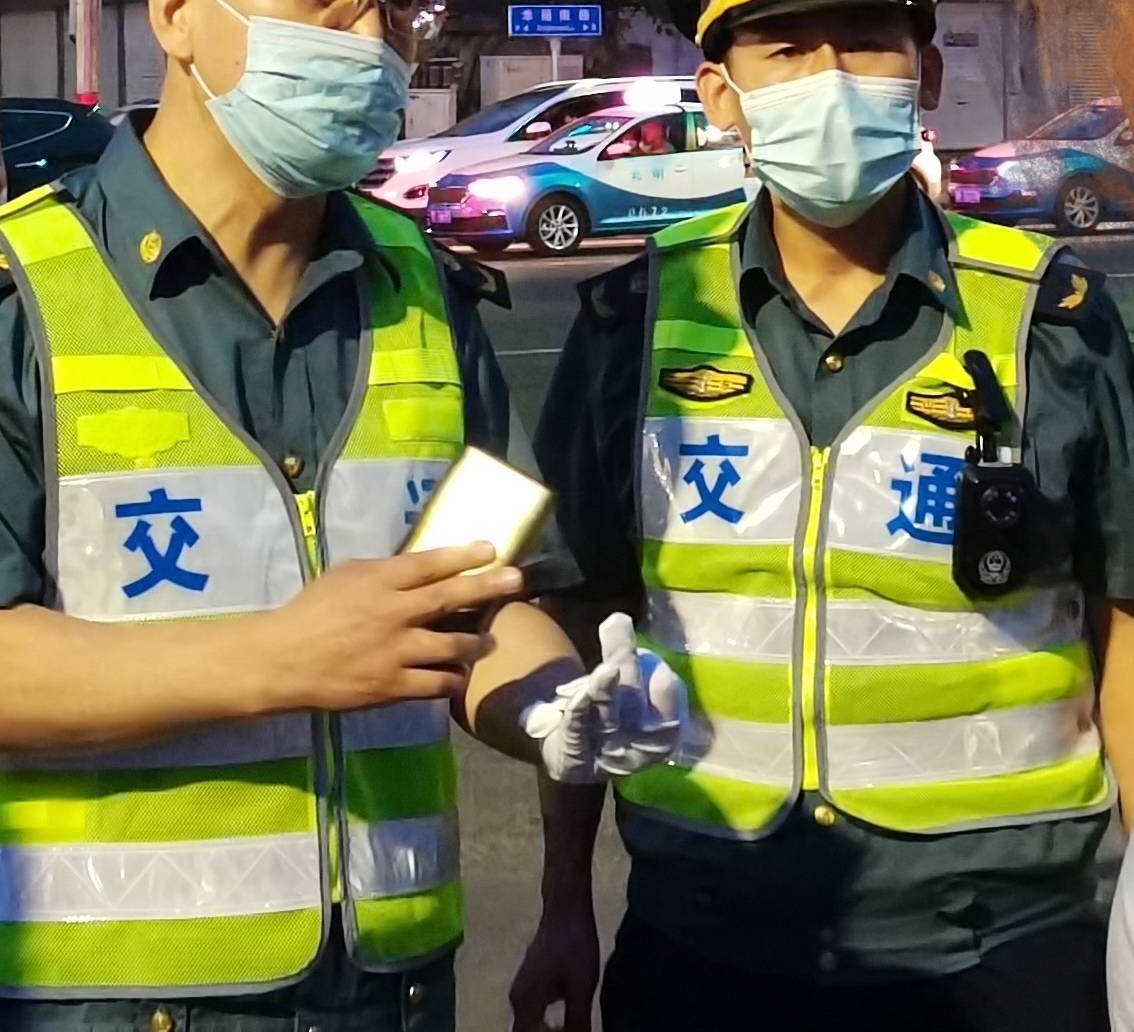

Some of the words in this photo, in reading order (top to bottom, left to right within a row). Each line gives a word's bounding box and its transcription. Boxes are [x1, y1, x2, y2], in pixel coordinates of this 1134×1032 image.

[113, 487, 211, 599] 交
[680, 434, 749, 525] 交
[885, 452, 966, 546] 通
